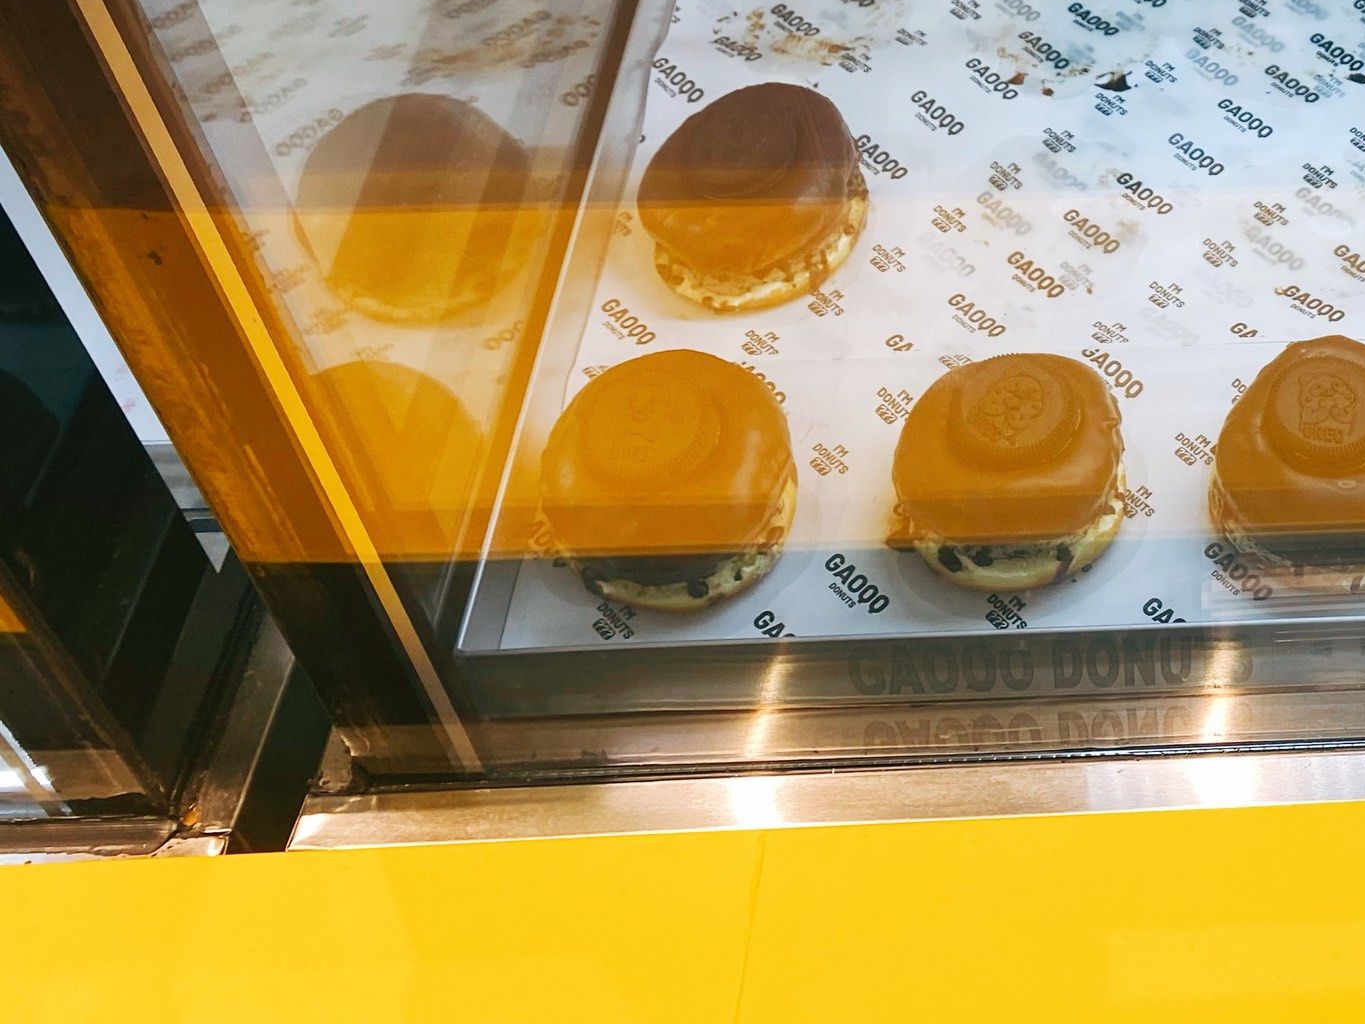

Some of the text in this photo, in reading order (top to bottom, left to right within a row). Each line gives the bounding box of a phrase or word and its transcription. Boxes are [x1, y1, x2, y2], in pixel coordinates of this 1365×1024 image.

[1303, 163, 1337, 189] DONUTS
[1175, 433, 1213, 465] DONUTS
[829, 582, 856, 608] DONUTS
[987, 594, 1027, 630] DONUTS
[1053, 631, 1255, 689] DONUS
